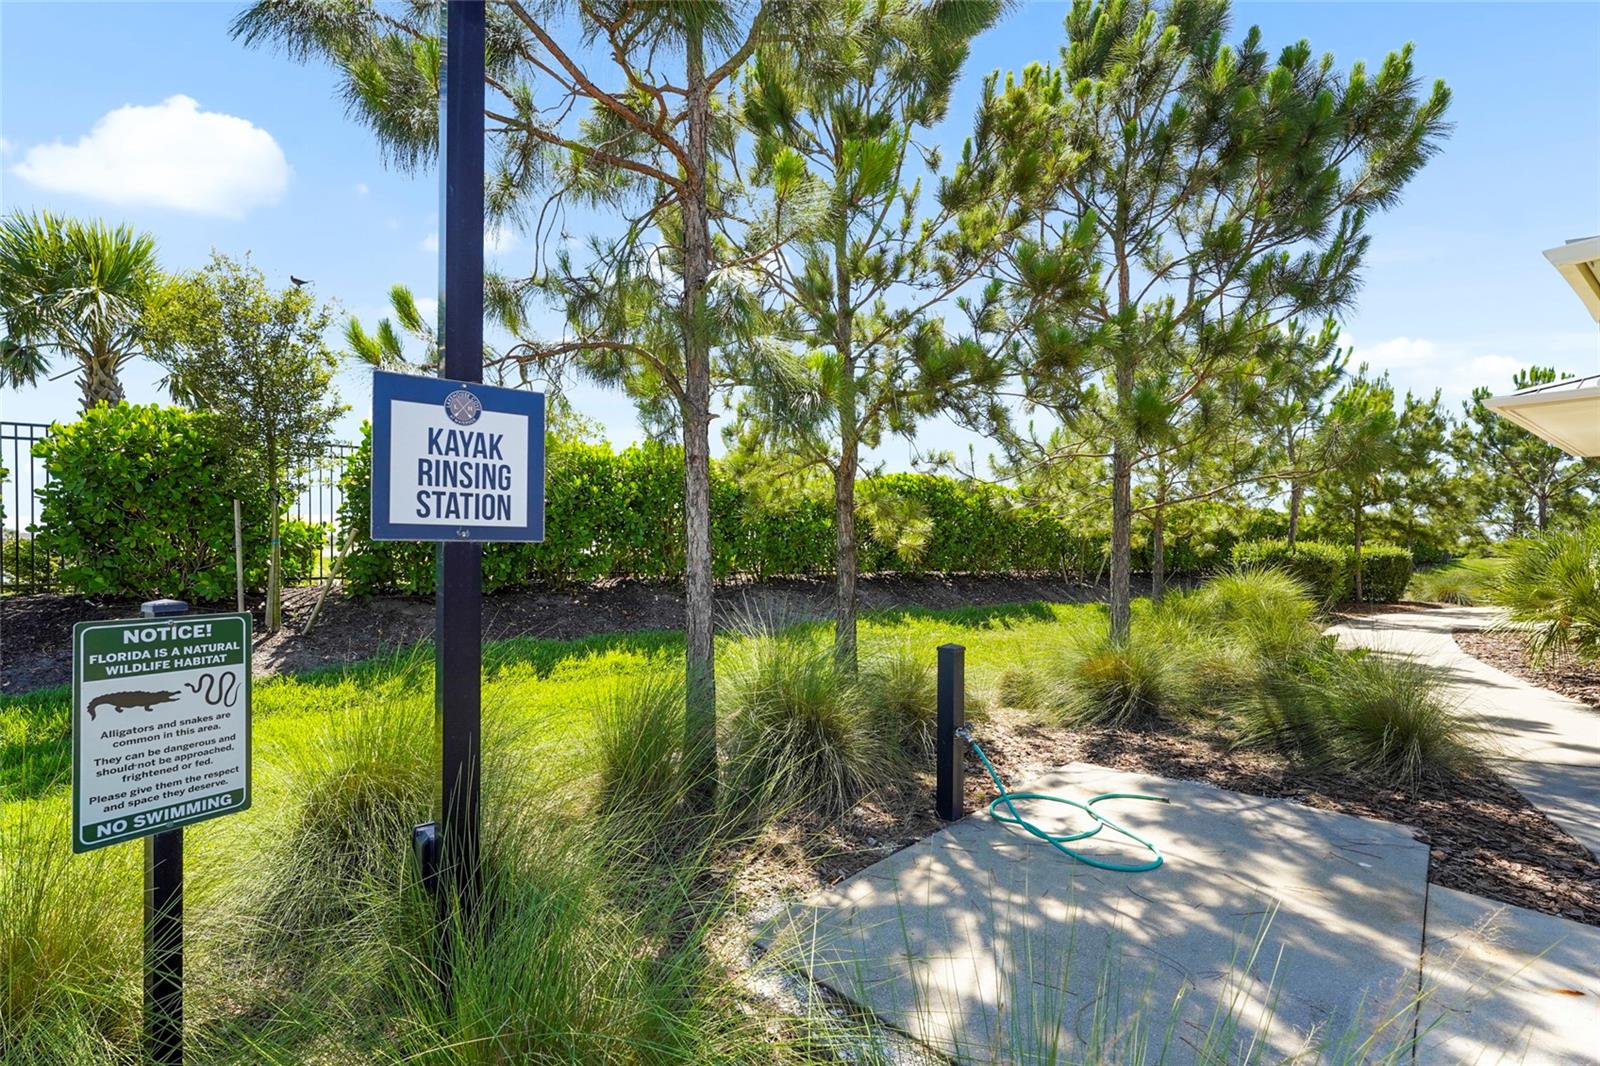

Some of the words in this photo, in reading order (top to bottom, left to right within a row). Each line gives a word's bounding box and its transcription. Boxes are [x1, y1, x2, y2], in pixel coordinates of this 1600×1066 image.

[428, 427, 503, 460] KAYAK
[418, 458, 511, 490] RINSING
[416, 490, 511, 520] STATION
[123, 624, 212, 644] NOTICE!
[89, 650, 151, 664] FLORIDA
[155, 648, 168, 657] IS
[171, 647, 180, 656] A
[183, 642, 240, 654] NATURAL
[105, 661, 170, 675] WILDLIFE
[174, 654, 227, 667] HABITAT
[101, 725, 154, 739] Alligators
[157, 720, 177, 730] and
[179, 714, 213, 726] snakes
[112, 734, 160, 748] common
[163, 731, 173, 739] in
[176, 728, 195, 737] this
[197, 724, 221, 733] area.
[94, 757, 126, 766] They
[125, 752, 145, 761] can
[148, 747, 161, 756] be
[163, 738, 216, 753] dangerous
[218, 733, 236, 742] and
[96, 763, 135, 777] should
[137, 760, 156, 769] not
[159, 756, 172, 765] be
[122, 765, 179, 782] frightened
[195, 758, 213, 767] fed.
[89, 791, 127, 805] Please
[130, 786, 152, 797] give
[156, 780, 182, 790] them
[185, 775, 201, 784] the
[203, 766, 239, 782] respect
[103, 802, 124, 813] and
[128, 795, 160, 808] space
[162, 788, 185, 800] they
[188, 779, 228, 792] deserve.
[97, 820, 127, 838] NO
[133, 794, 232, 828] SWIMMING
